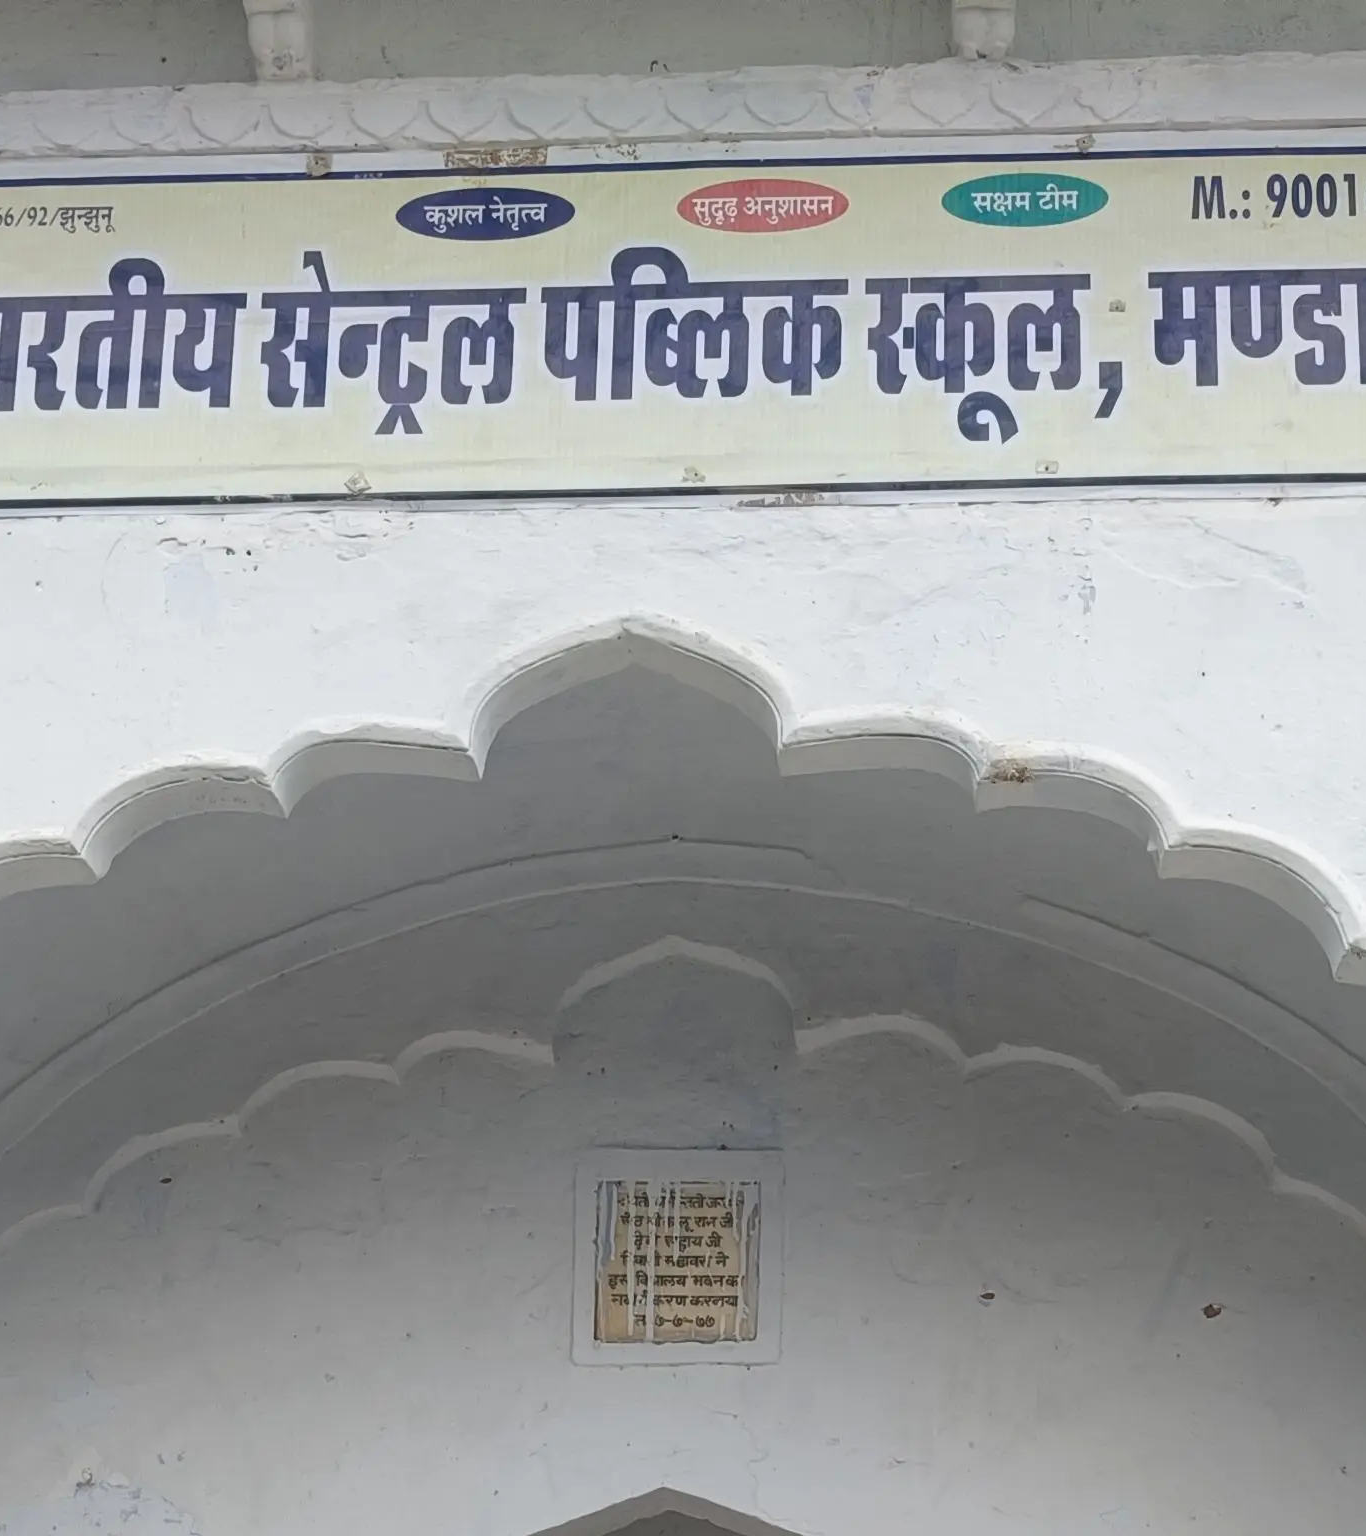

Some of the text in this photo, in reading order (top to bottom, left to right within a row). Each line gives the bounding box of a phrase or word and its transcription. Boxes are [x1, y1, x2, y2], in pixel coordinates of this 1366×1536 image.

[423, 196, 548, 233] कुशल नेतृत्व
[743, 196, 834, 224] अनुशासन
[971, 183, 1079, 216] सक्षम टीम
[261, 250, 527, 436] सेन्ट्रल
[541, 246, 848, 401] पब्लिक
[865, 273, 1123, 444] स्कूल,
